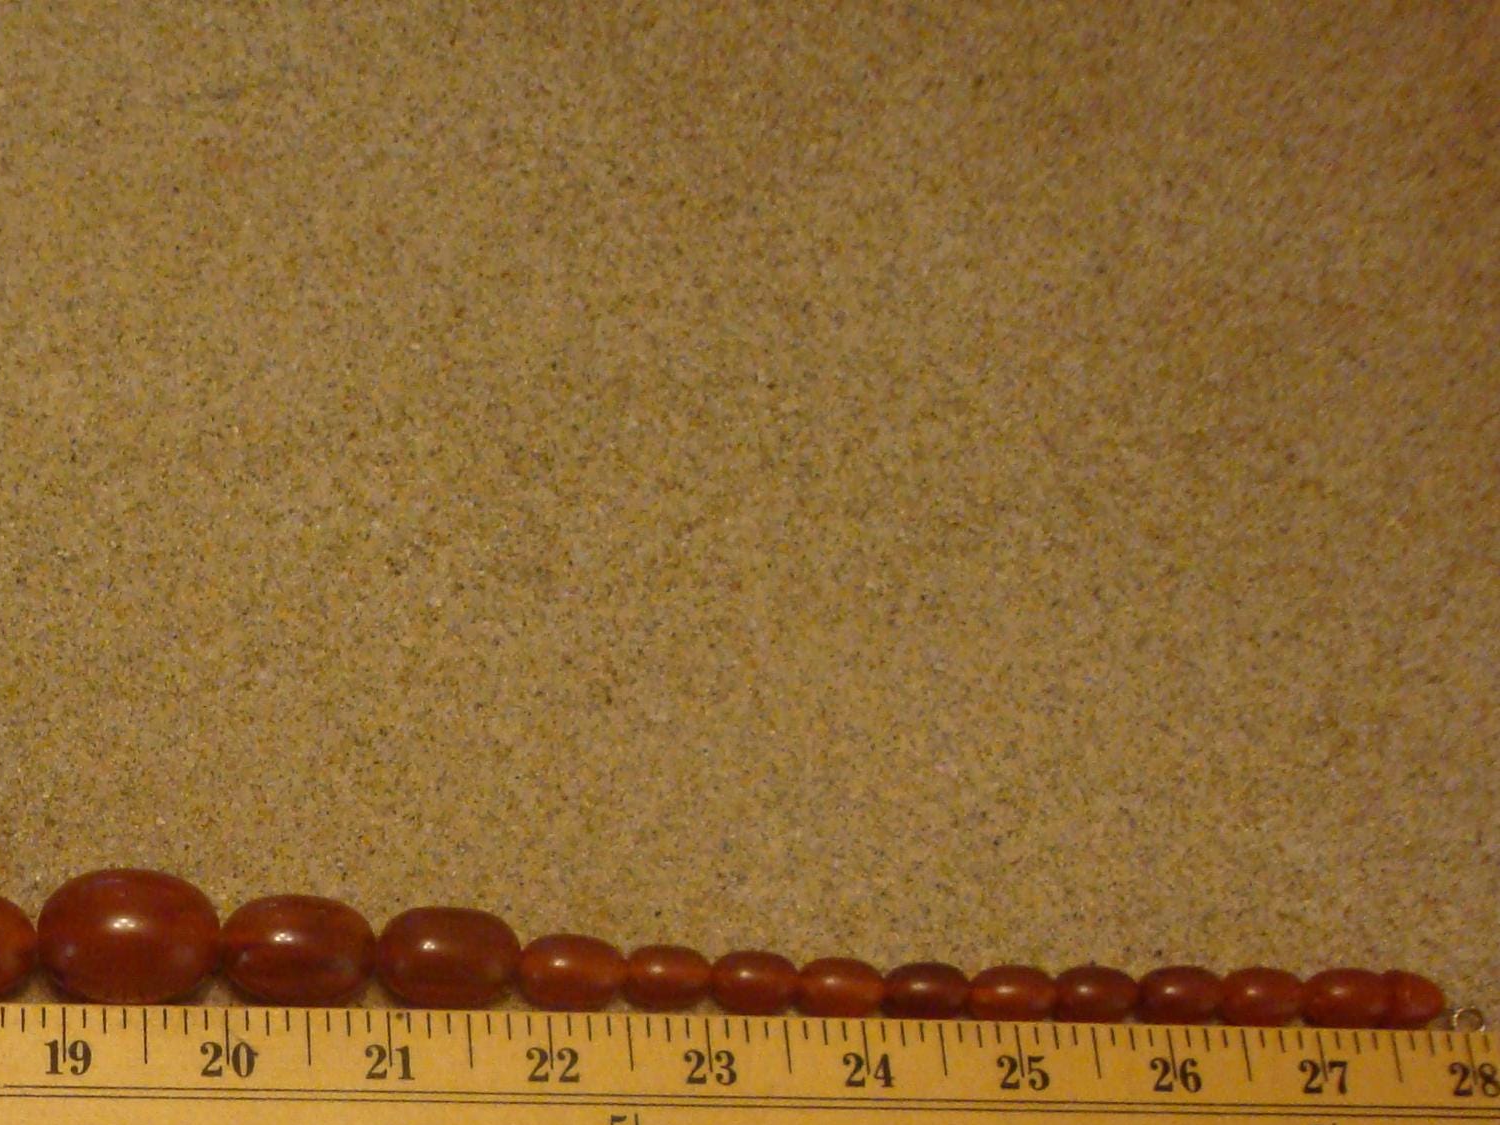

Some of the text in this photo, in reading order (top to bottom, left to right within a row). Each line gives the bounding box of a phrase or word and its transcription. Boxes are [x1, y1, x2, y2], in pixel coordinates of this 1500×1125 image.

[45, 1039, 92, 1076] 19
[199, 1042, 256, 1079] 20
[365, 1045, 416, 1081] 21
[526, 1047, 581, 1083] 22
[683, 1050, 738, 1086] 23
[842, 1053, 896, 1089] 24
[996, 1056, 1051, 1092] 25
[1150, 1059, 1203, 1093] 26
[1298, 1061, 1349, 1095] 27
[1449, 1063, 1500, 1098] 28
